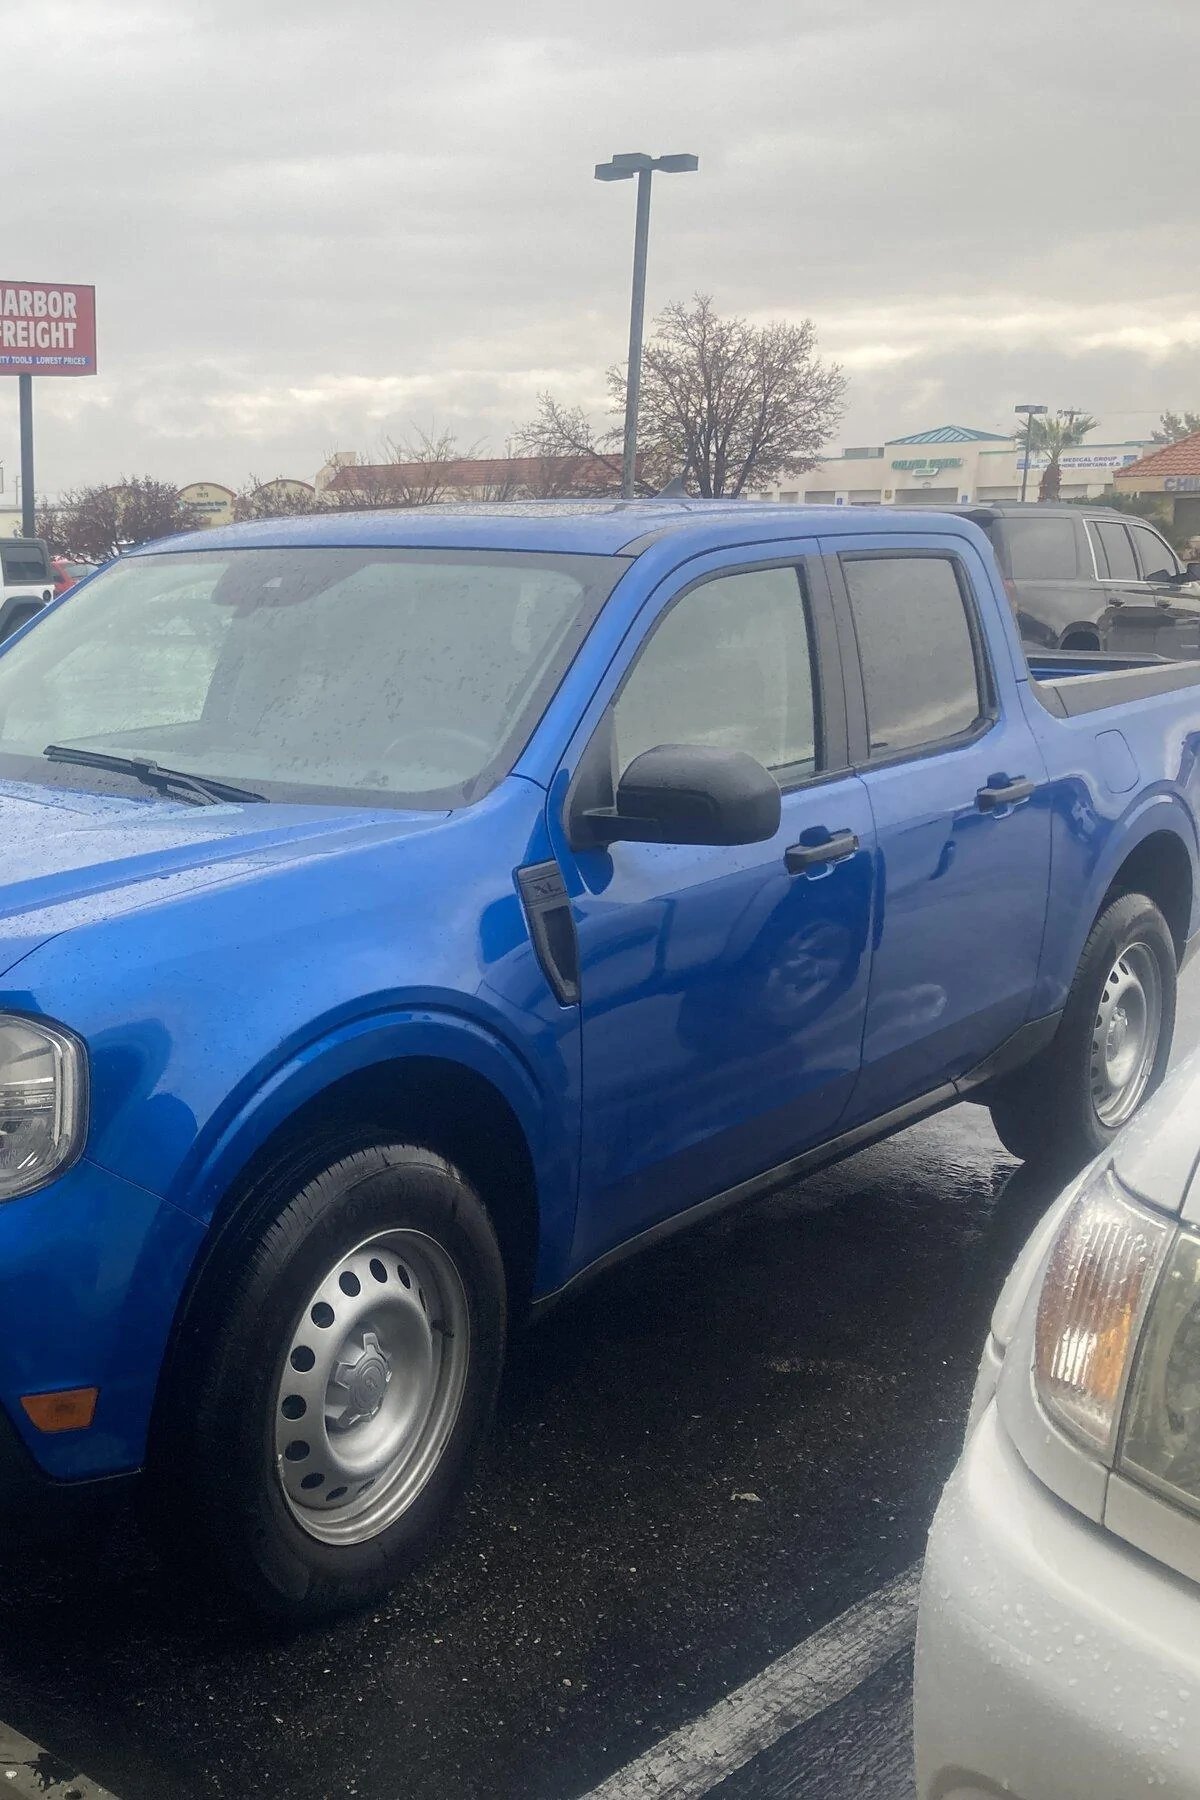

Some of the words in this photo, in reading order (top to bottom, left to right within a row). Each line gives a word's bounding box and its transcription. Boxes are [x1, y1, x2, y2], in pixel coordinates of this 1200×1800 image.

[11, 356, 33, 364] TOOLS
[36, 356, 62, 365] LOWEST
[63, 357, 86, 365] PRICES
[532, 882, 561, 896] XL
